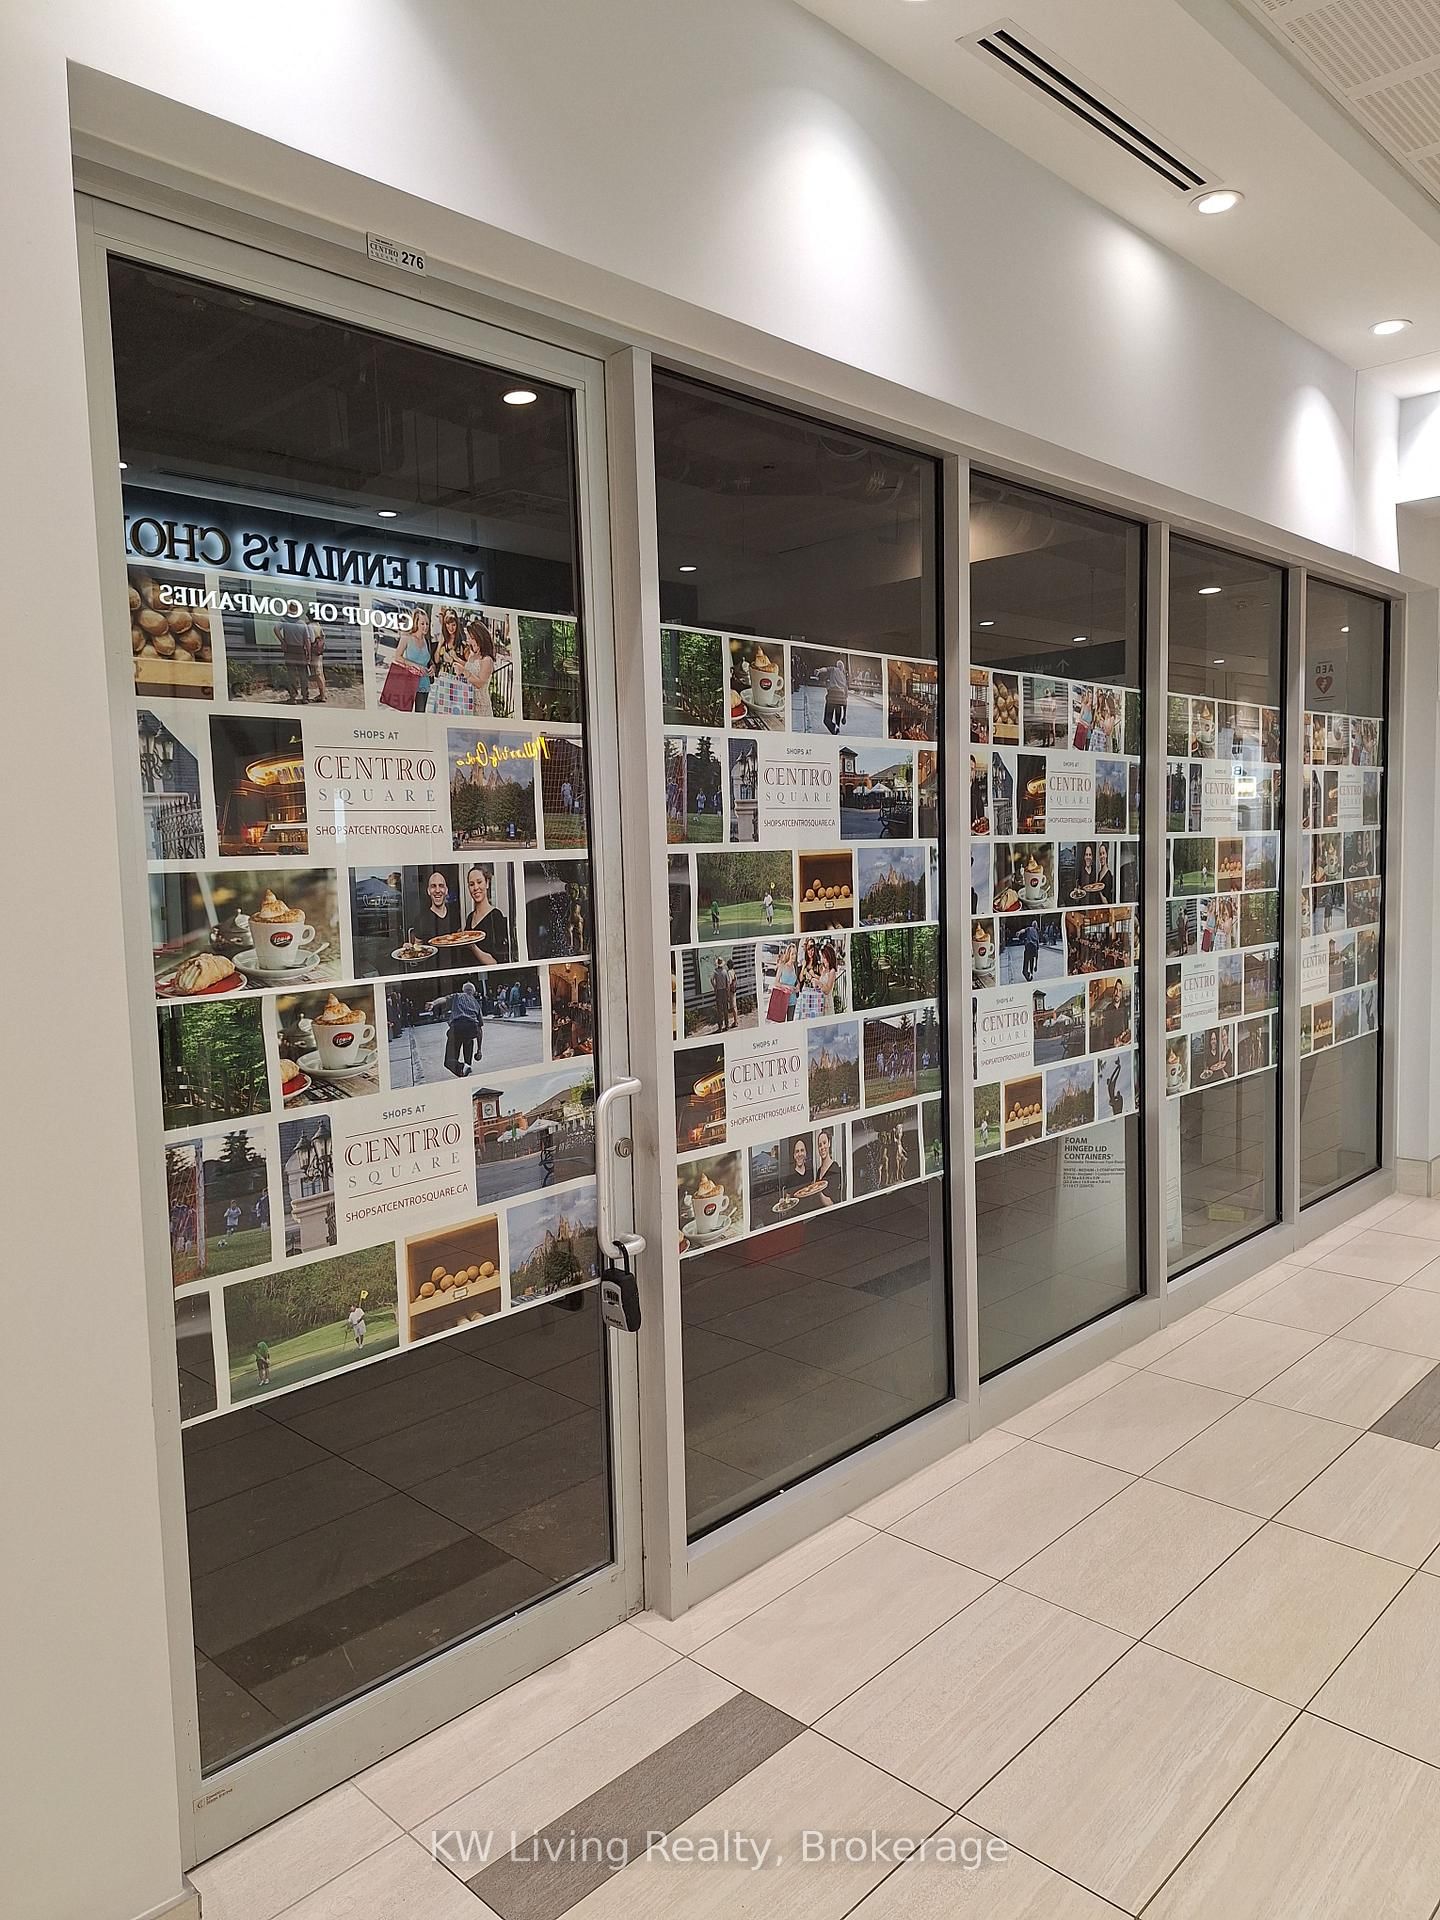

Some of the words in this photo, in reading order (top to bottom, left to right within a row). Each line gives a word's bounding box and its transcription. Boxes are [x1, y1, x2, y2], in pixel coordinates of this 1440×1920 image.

[401, 251, 425, 270] 276
[353, 729, 385, 740] SHOPS
[388, 731, 400, 740] AT
[786, 747, 805, 755] SHOPS
[314, 755, 437, 781] CENTRO
[763, 767, 833, 787] CENTRO
[1049, 776, 1092, 791] CENTRO
[318, 787, 436, 805] SQUARE
[765, 791, 832, 804] SQUARE
[316, 824, 444, 836] SHOPSATCENTROSQUARE.CA
[982, 1010, 1029, 1032] CENTRO
[752, 1040, 771, 1050] SHOPS
[730, 1055, 801, 1085] CENTRO
[732, 1078, 800, 1101] SQUARE
[382, 1106, 413, 1120] SHOPS
[415, 1104, 427, 1114] AT
[344, 1122, 461, 1167] CENTRO
[347, 1151, 460, 1189] SQUARE
[345, 1183, 470, 1223] SHOPSATCENTROSQUARE.CA
